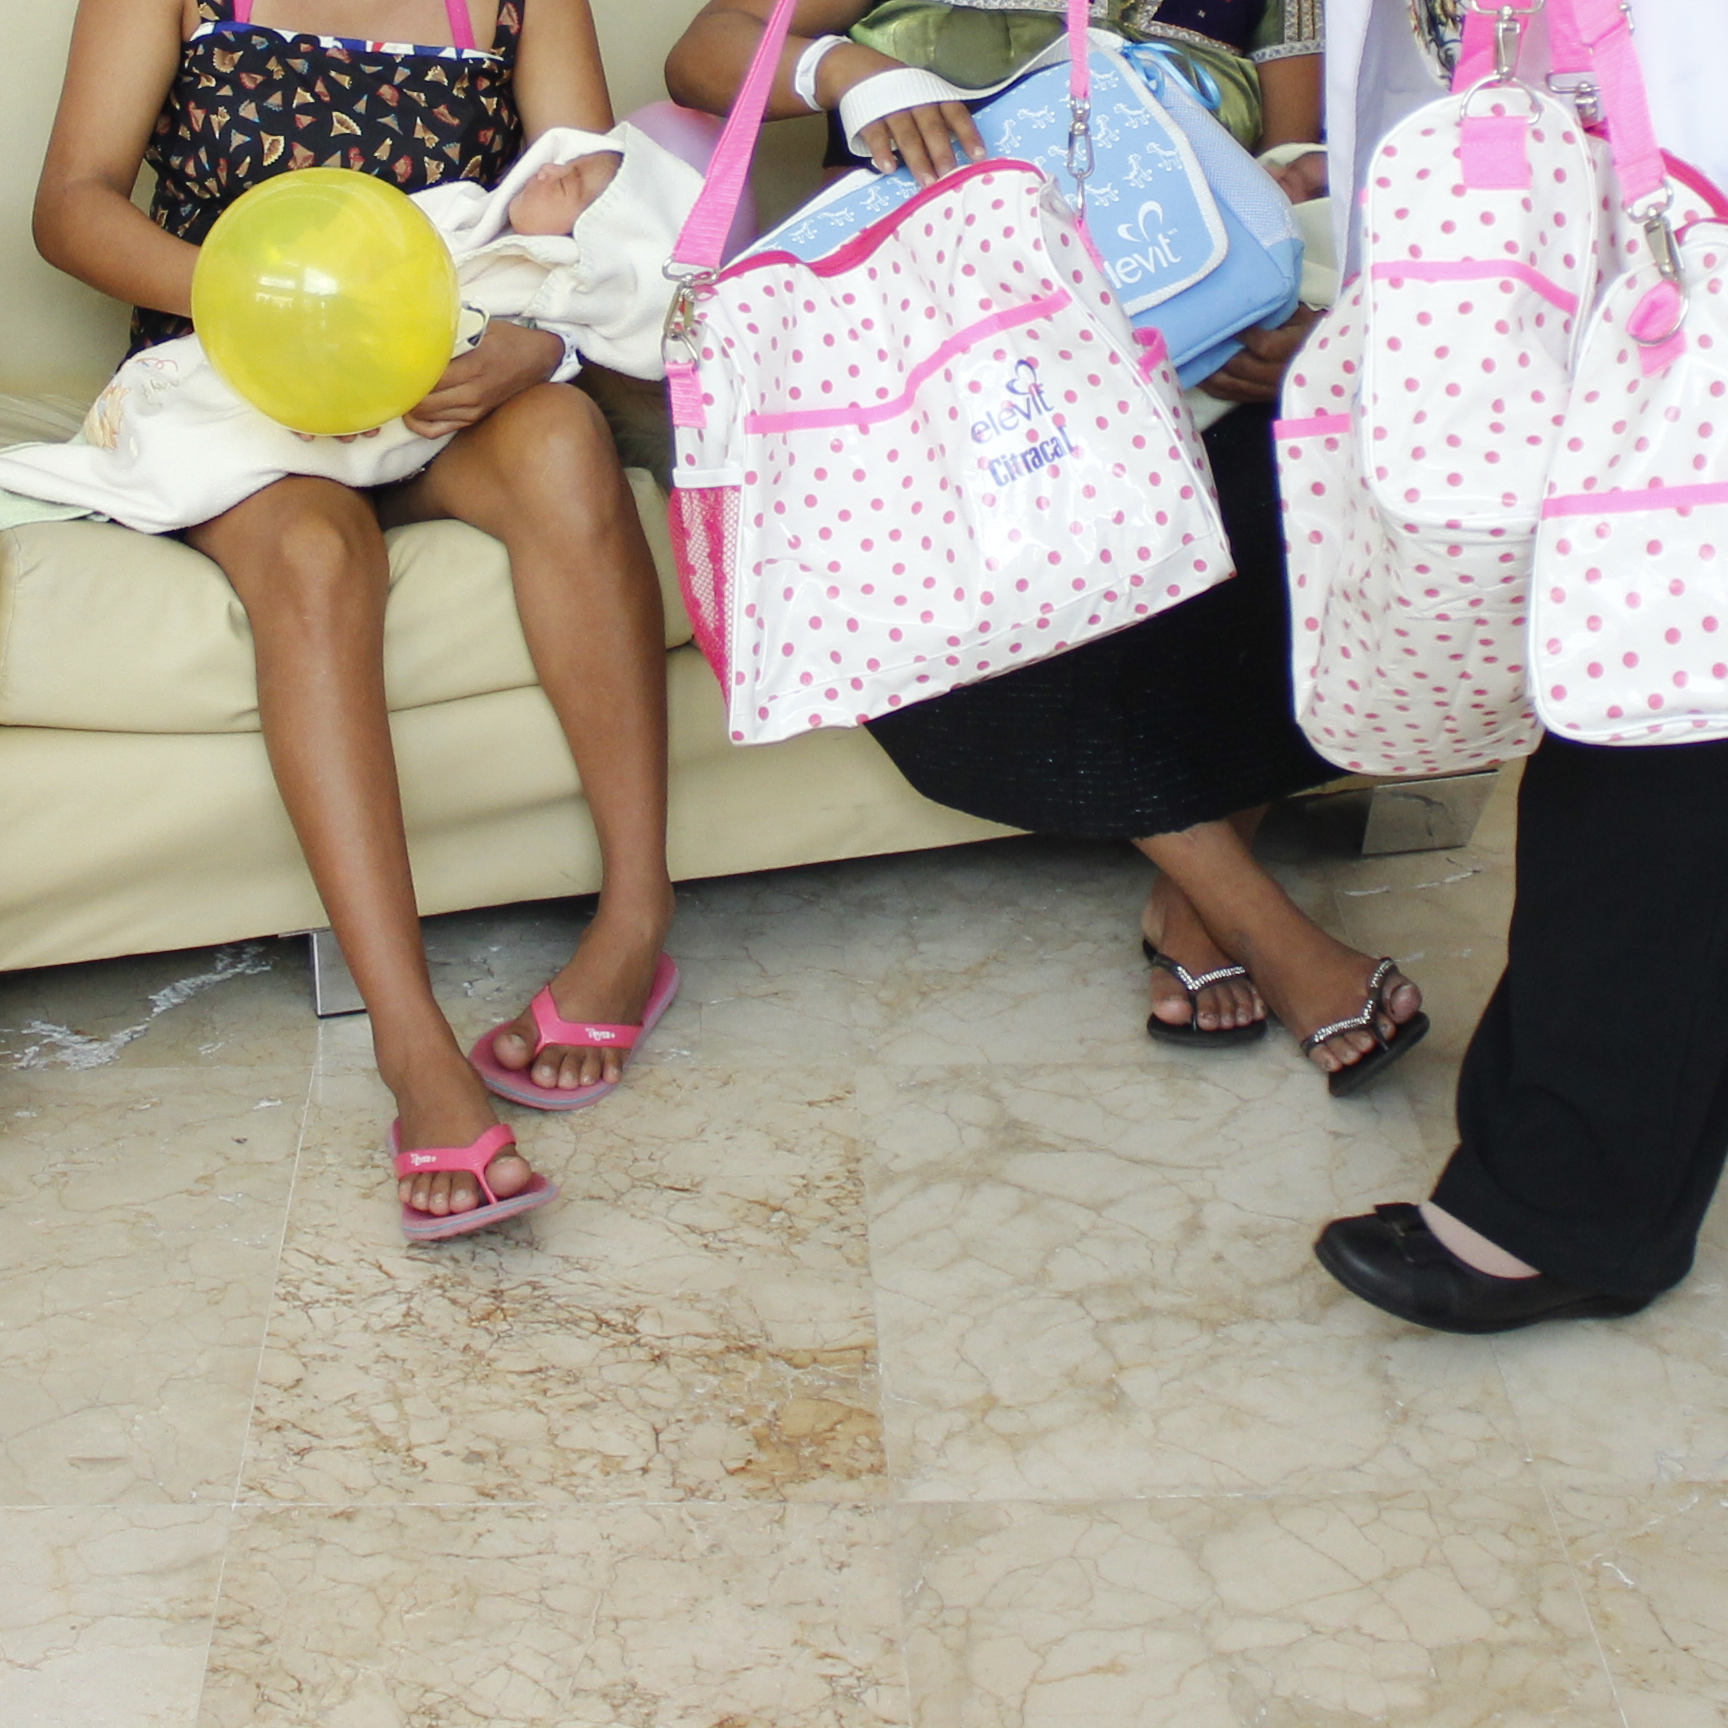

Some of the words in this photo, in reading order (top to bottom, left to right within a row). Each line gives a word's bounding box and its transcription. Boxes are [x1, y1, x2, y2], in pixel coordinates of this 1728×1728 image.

[1103, 232, 1182, 289] levit
[971, 382, 1054, 444] elevit
[988, 422, 1074, 487] Citracal
